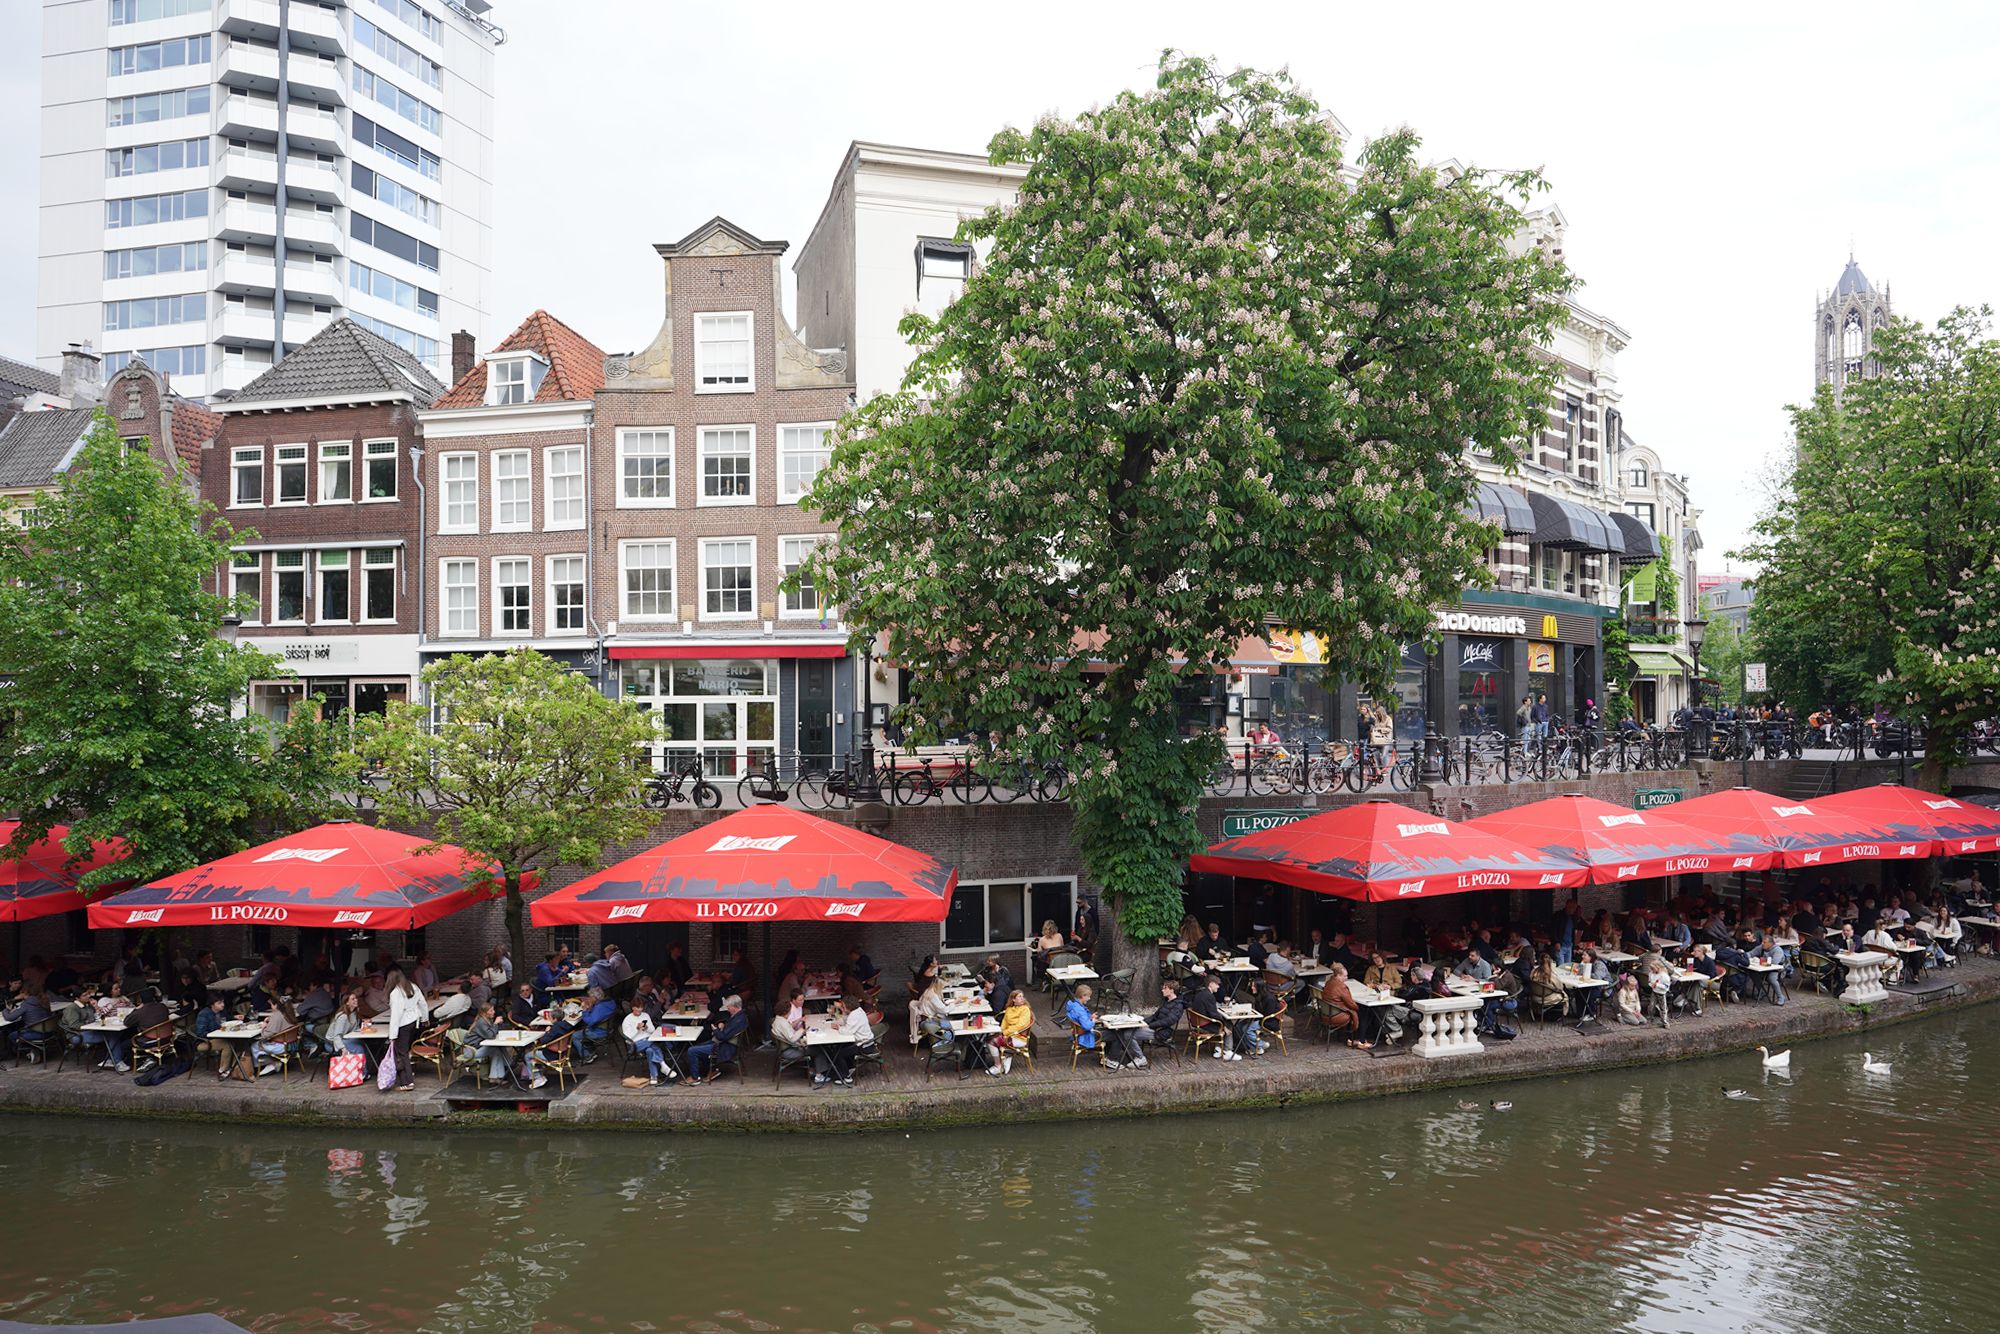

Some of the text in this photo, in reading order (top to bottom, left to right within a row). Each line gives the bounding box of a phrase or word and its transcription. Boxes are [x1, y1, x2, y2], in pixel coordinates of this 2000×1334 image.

[1437, 612, 1527, 634] McDonald's
[698, 679, 739, 689] MARIO
[1640, 794, 1676, 805] IL POZZO
[1235, 817, 1251, 829] IL
[1843, 845, 1880, 858] IL POZZO
[1665, 858, 1709, 871] IL POZZO
[1457, 873, 1510, 888] IL POZZO
[211, 905, 288, 921] IL POZZO
[696, 902, 778, 917] IL POZZO
